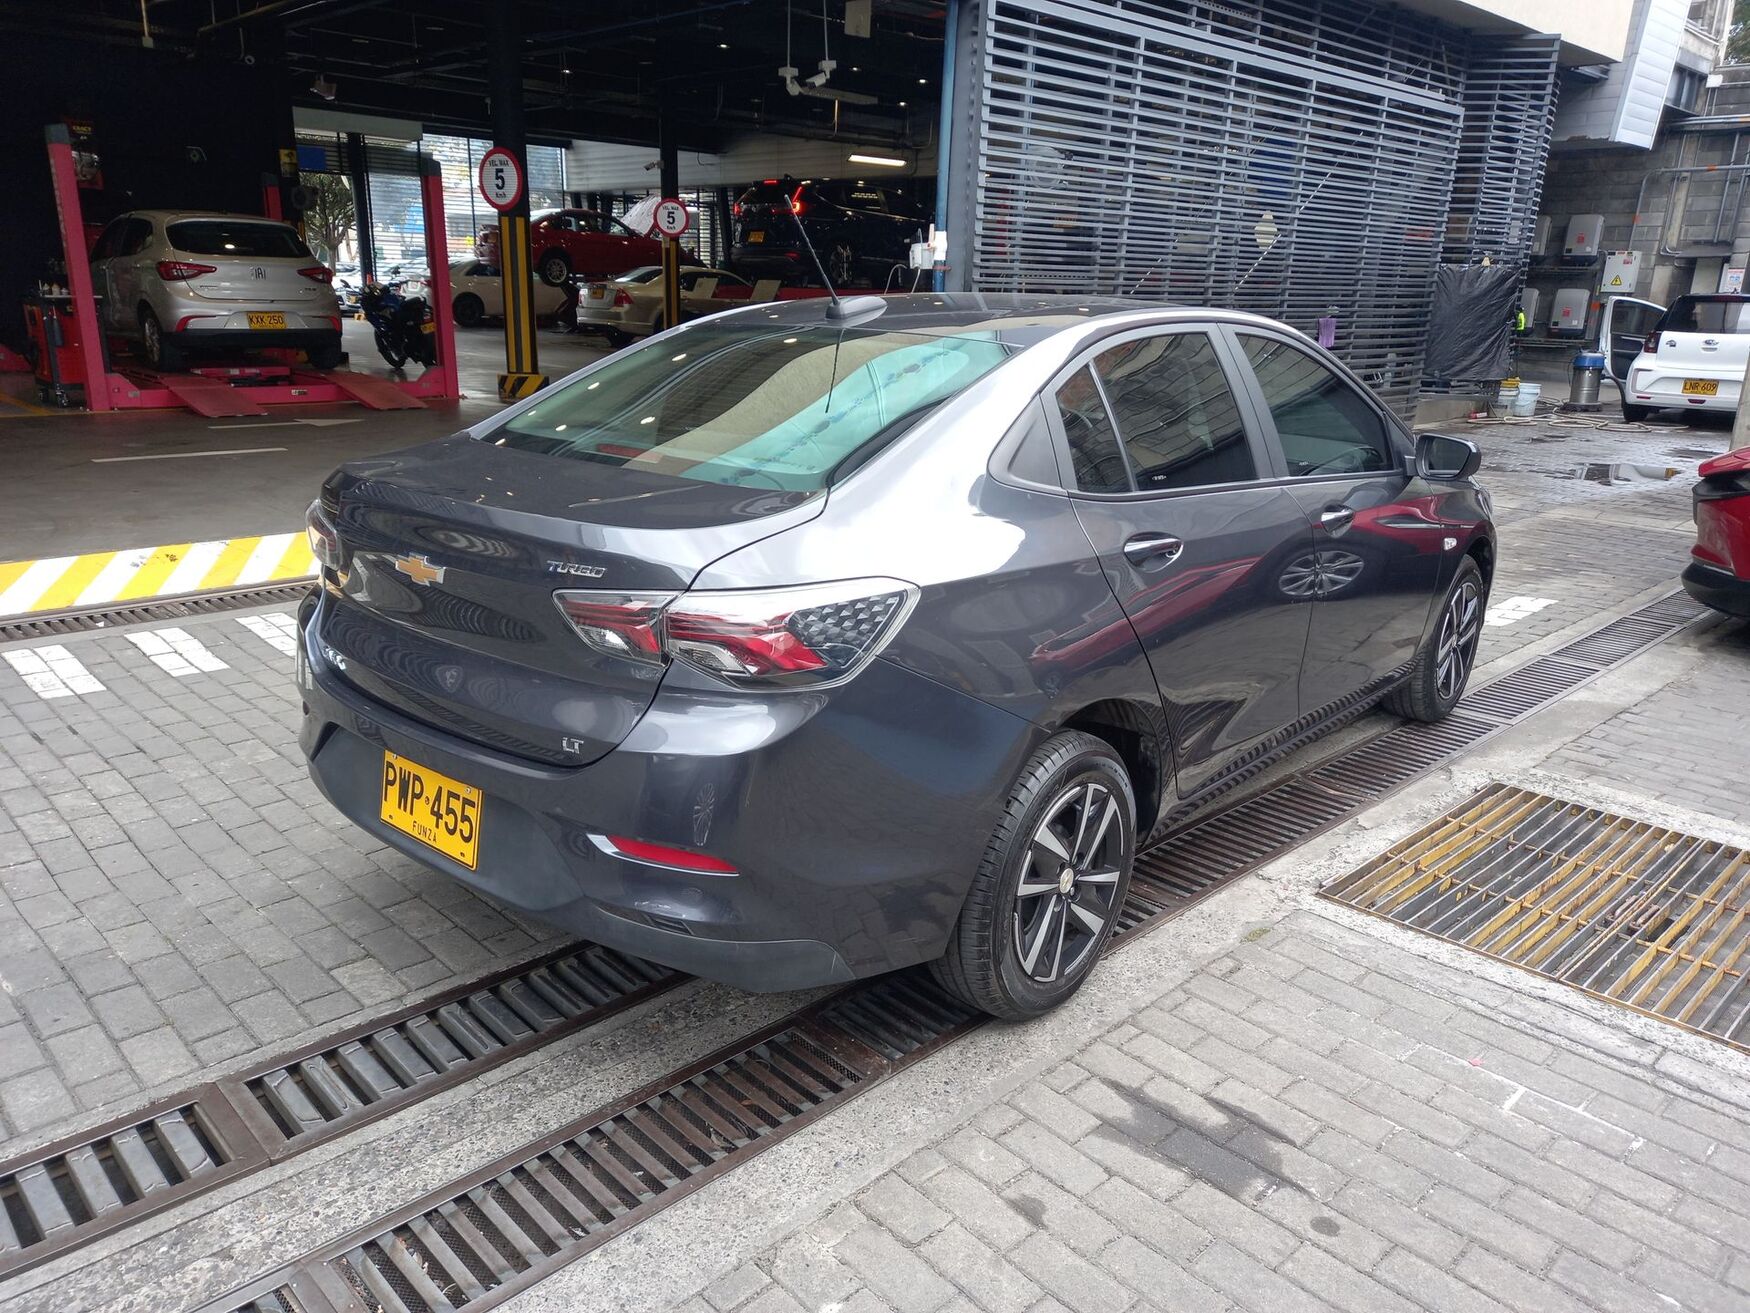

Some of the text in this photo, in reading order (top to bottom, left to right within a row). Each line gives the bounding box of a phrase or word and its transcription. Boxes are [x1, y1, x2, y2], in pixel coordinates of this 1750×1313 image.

[495, 168, 505, 190] 5
[667, 211, 676, 225] 5
[547, 560, 606, 578] TURBO
[562, 736, 584, 754] LT
[412, 820, 437, 843] FUNZA
